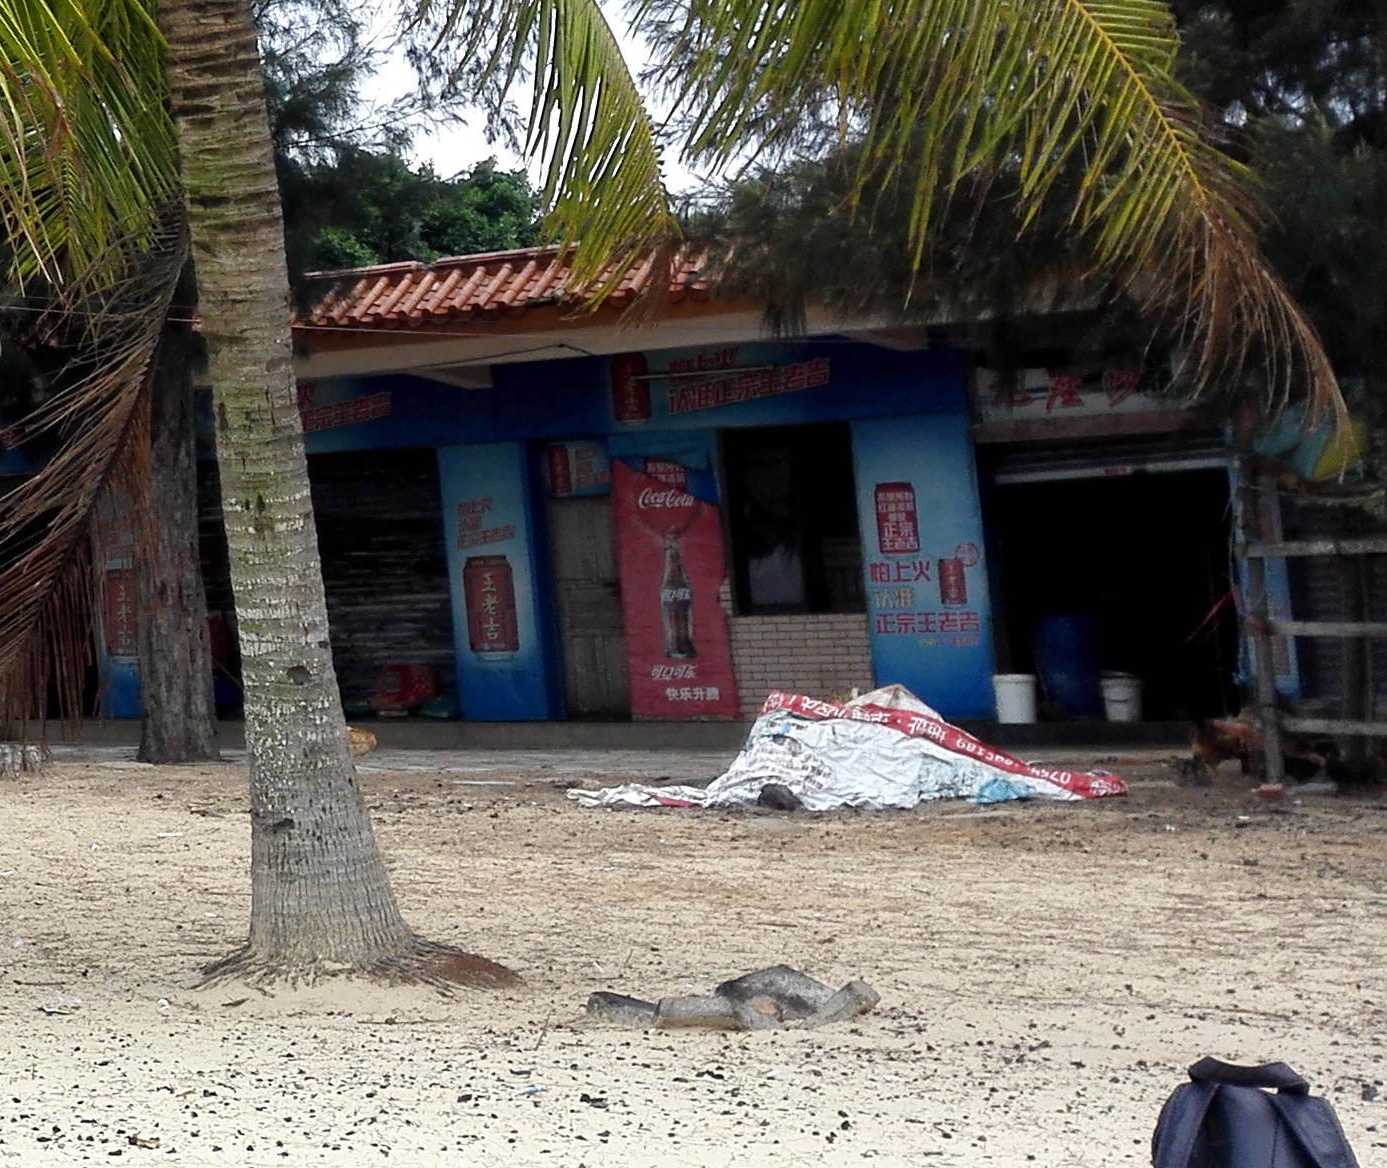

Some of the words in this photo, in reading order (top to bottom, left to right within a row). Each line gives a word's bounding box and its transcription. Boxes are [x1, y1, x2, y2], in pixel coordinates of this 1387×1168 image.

[883, 522, 913, 537] 正宗
[869, 561, 932, 583] 怕上火
[481, 572, 500, 640] 王老吉
[876, 611, 980, 635] 正宗王老吉
